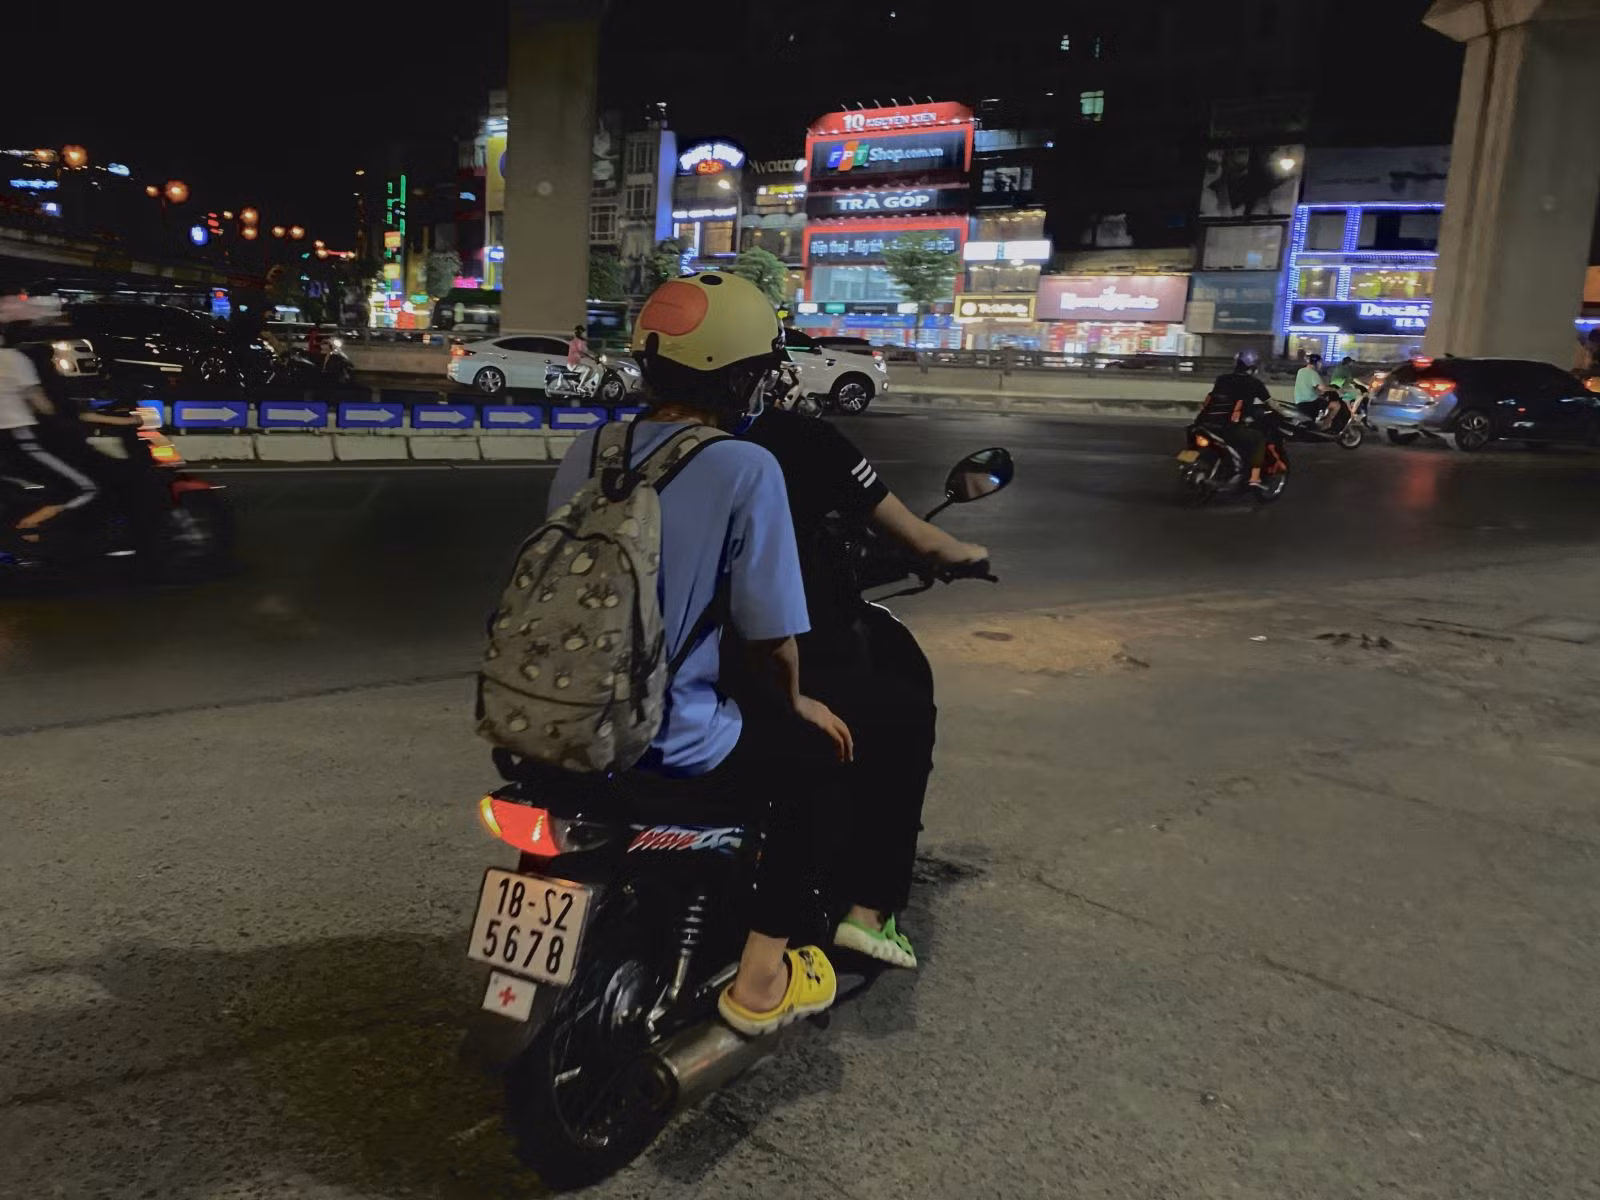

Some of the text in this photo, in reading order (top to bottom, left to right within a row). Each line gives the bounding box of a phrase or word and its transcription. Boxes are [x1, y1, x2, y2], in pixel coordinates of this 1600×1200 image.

[842, 113, 865, 130] 10
[869, 147, 944, 163] Shop.com.vn
[884, 190, 930, 208] GÓP
[497, 877, 574, 932] 18-S2
[482, 919, 564, 975] 5678
